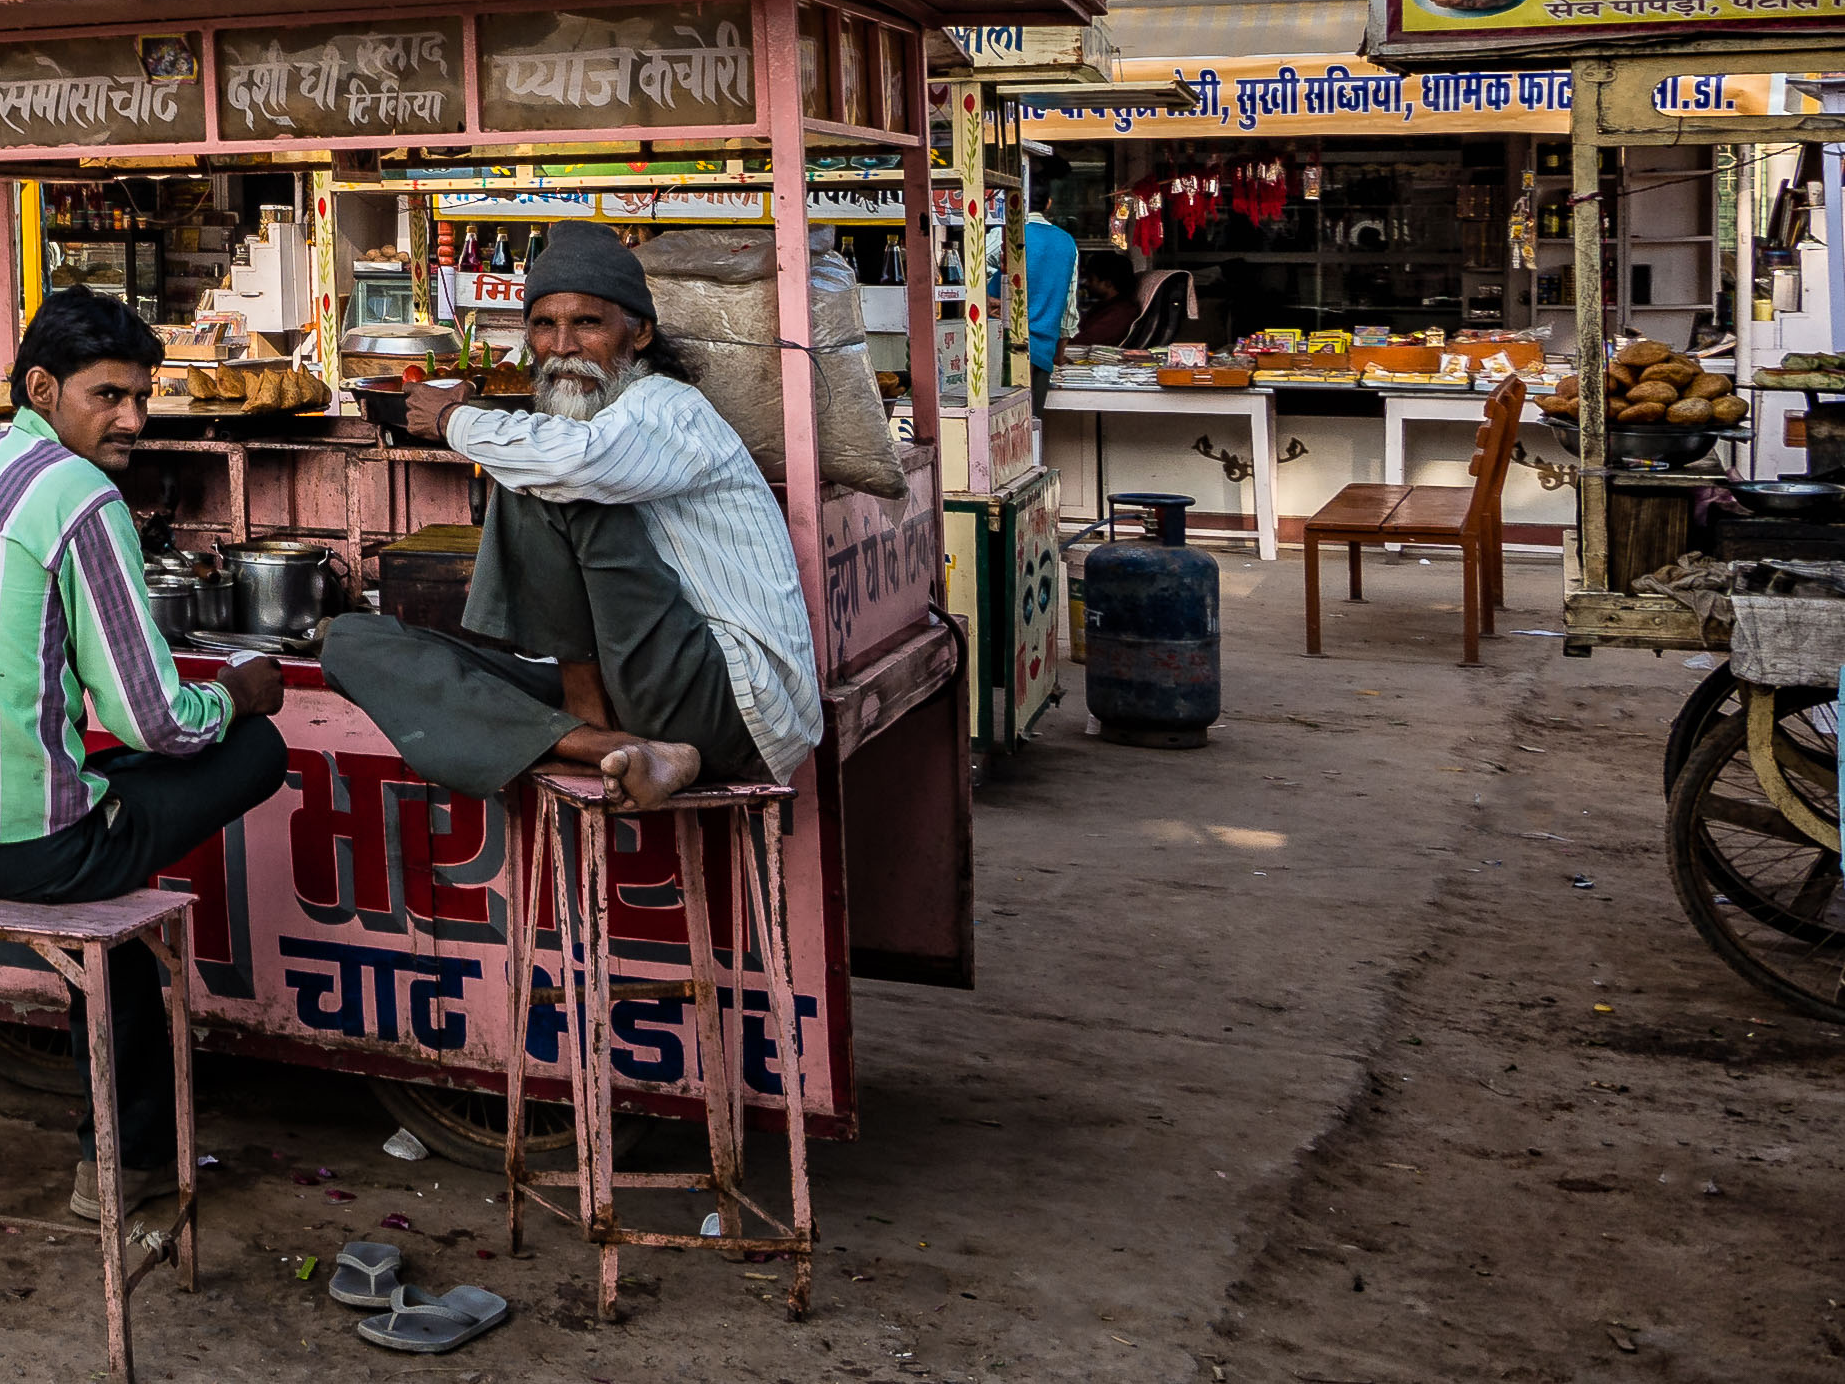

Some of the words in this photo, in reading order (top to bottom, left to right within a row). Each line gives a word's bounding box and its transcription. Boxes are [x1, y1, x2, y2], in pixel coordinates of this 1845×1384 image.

[493, 47, 638, 108] प्याज
[639, 20, 751, 109] कचोरी
[1236, 66, 1301, 131] सुखी
[279, 935, 483, 1052] चाट
